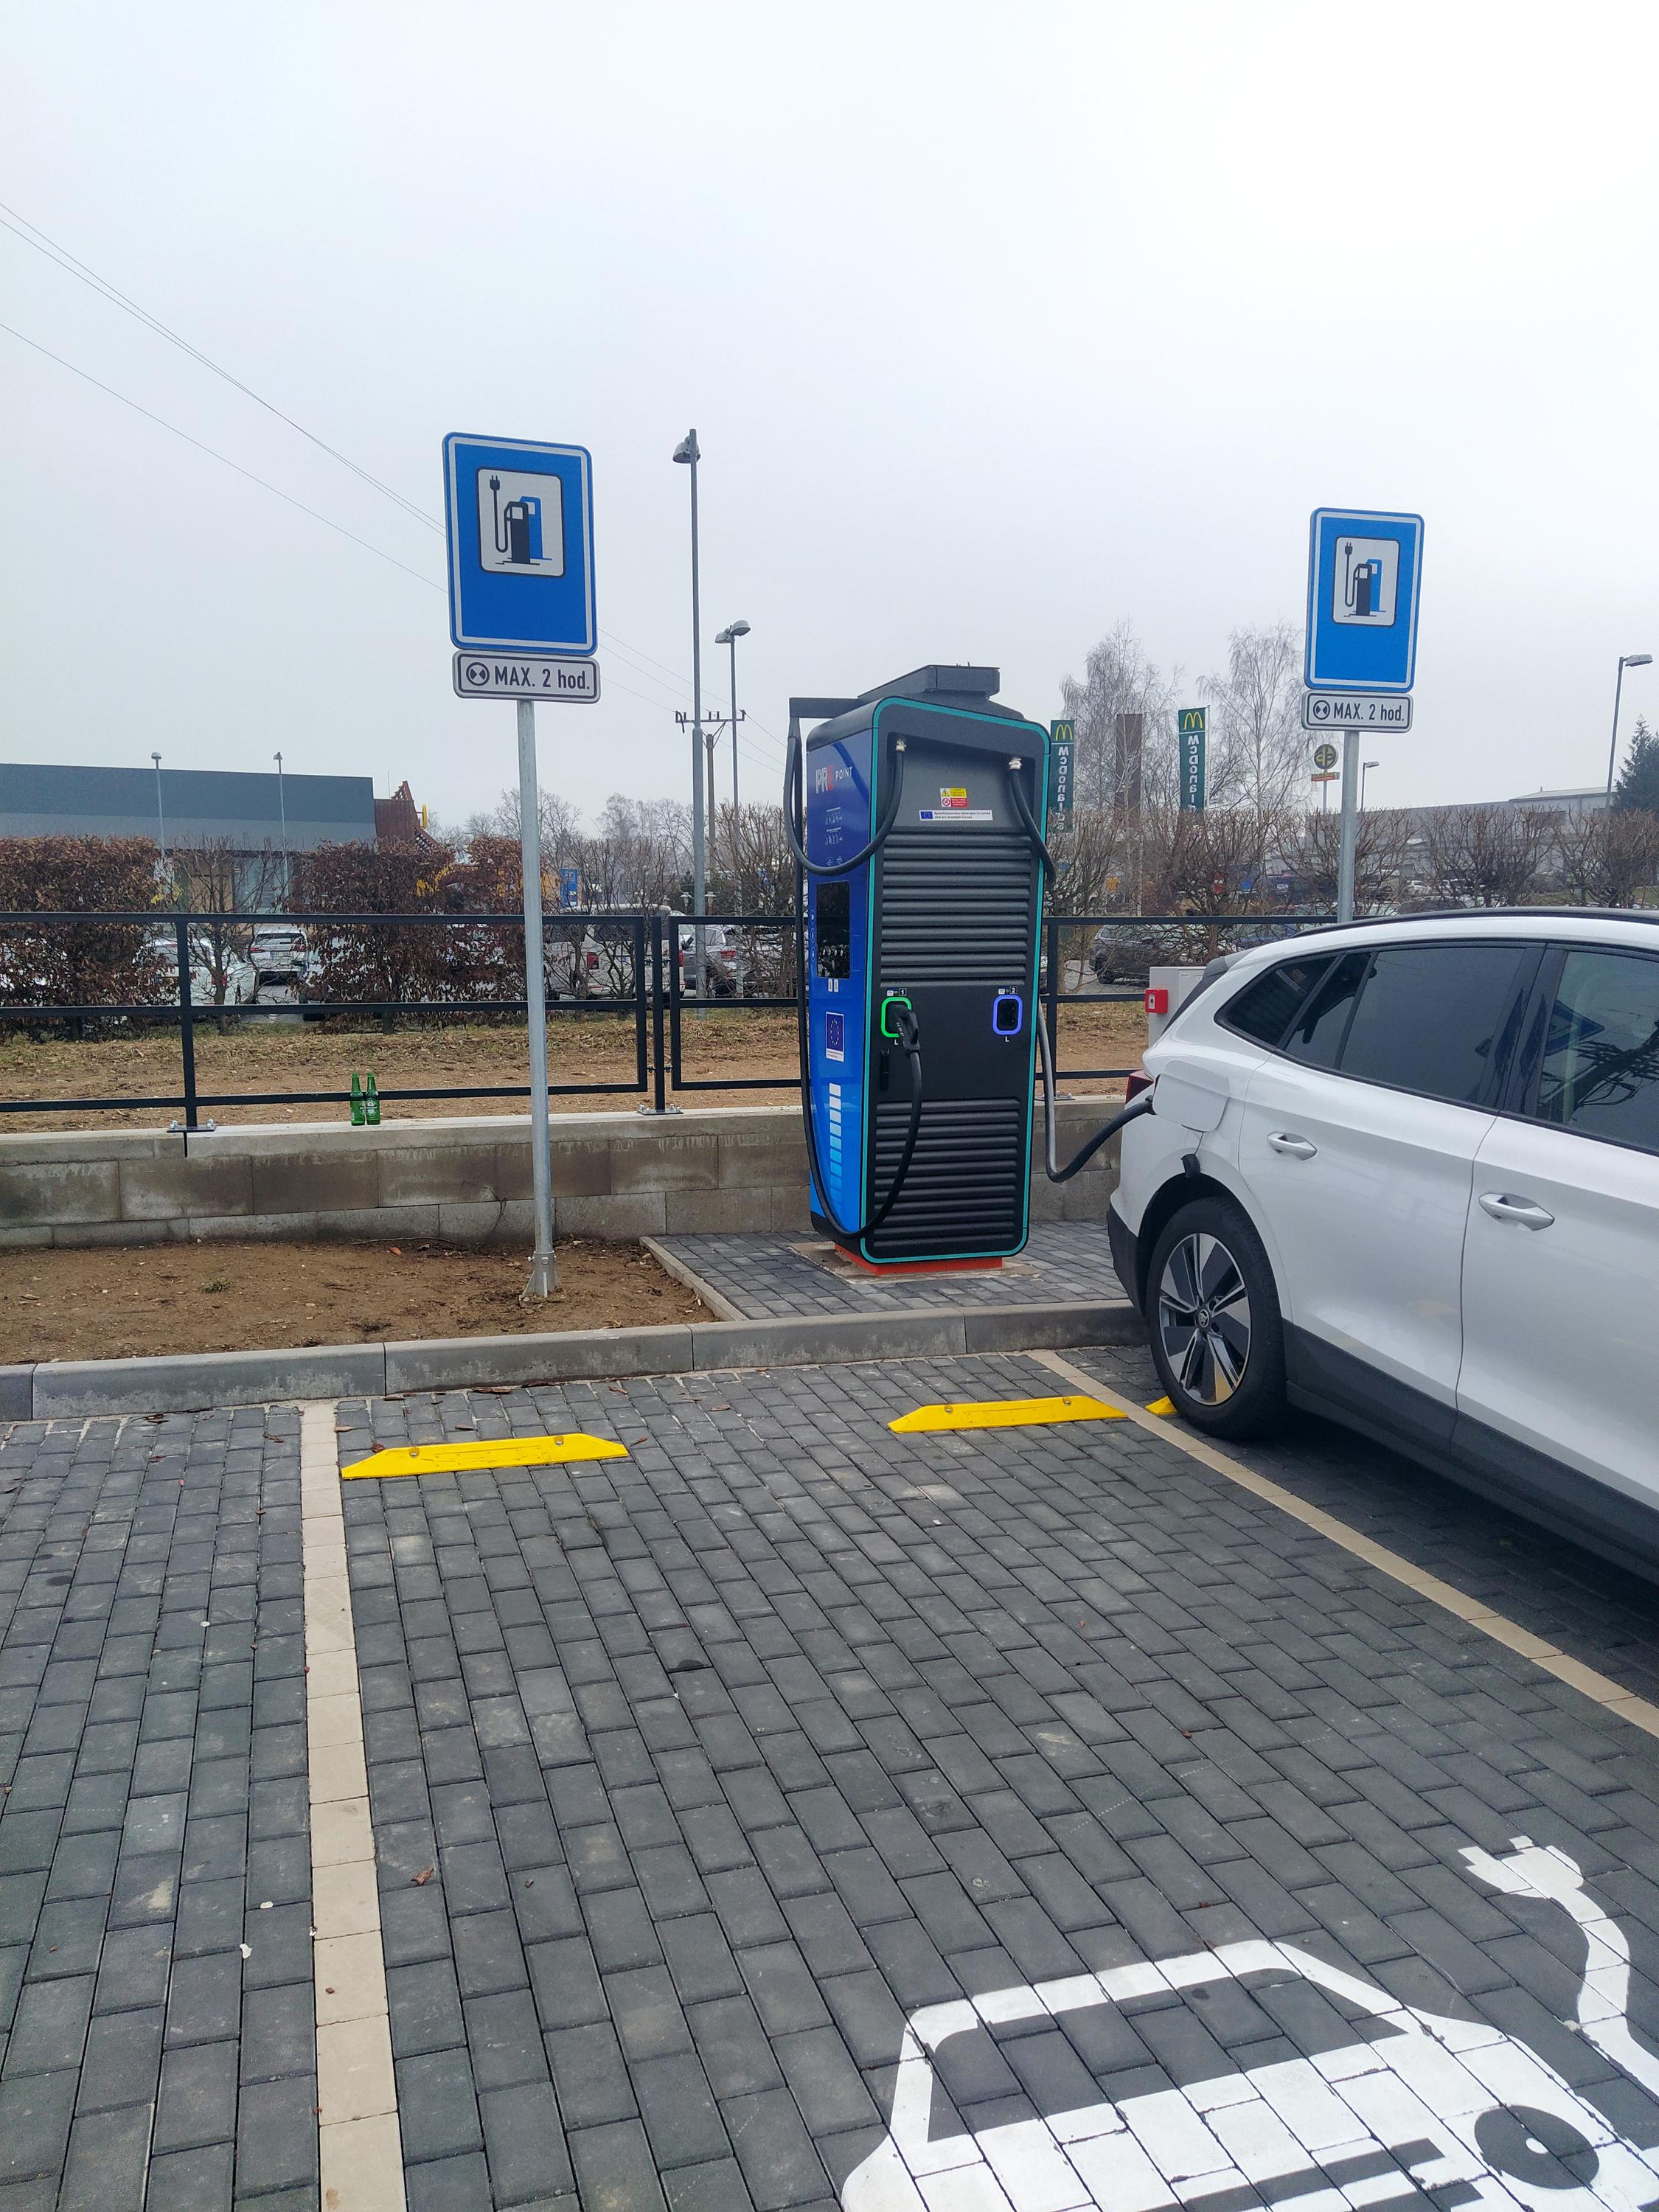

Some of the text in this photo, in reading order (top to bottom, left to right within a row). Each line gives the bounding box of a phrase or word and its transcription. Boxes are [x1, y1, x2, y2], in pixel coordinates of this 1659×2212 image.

[495, 665, 591, 690] MAX. 2 hod.
[1333, 702, 1405, 722] MAX. 2 hod.
[815, 765, 852, 794] PRE POINT
